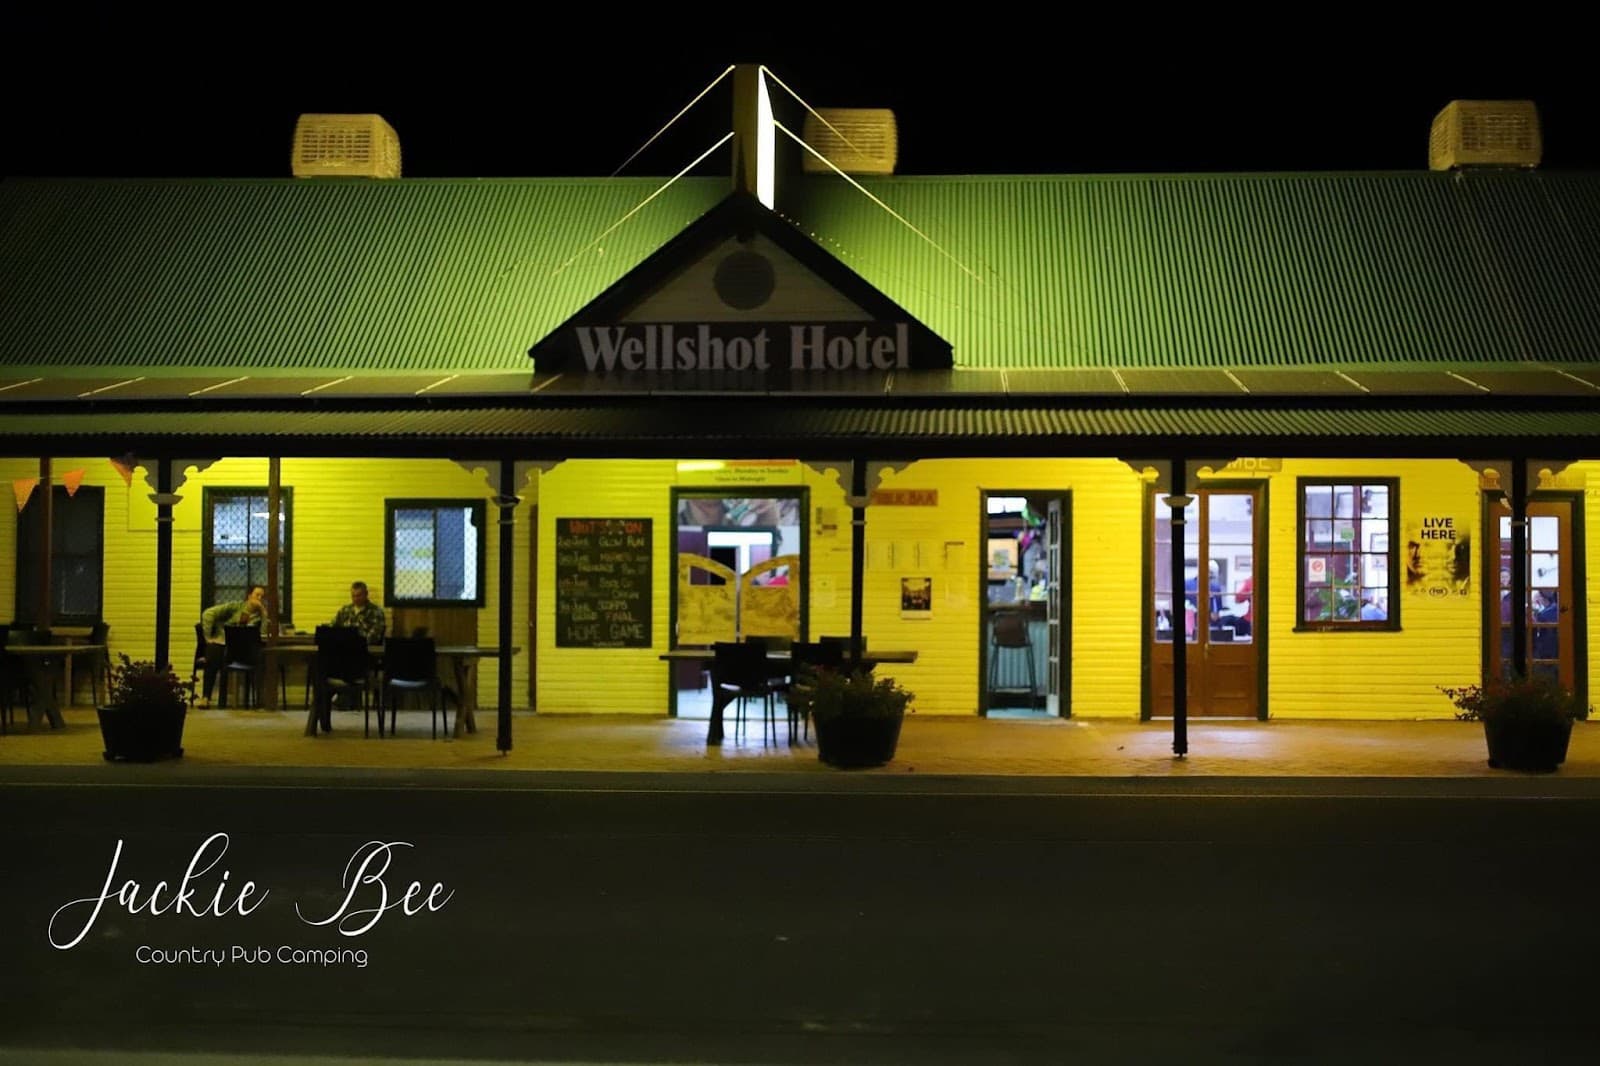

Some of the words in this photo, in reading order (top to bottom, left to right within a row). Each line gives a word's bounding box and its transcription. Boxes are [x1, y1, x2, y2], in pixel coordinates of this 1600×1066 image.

[575, 324, 771, 371] Wellshot
[789, 323, 910, 370] Hotel
[1424, 517, 1453, 528] LIVE
[1421, 529, 1456, 540] HERE
[568, 624, 600, 640] HOME
[609, 624, 645, 640] GAME
